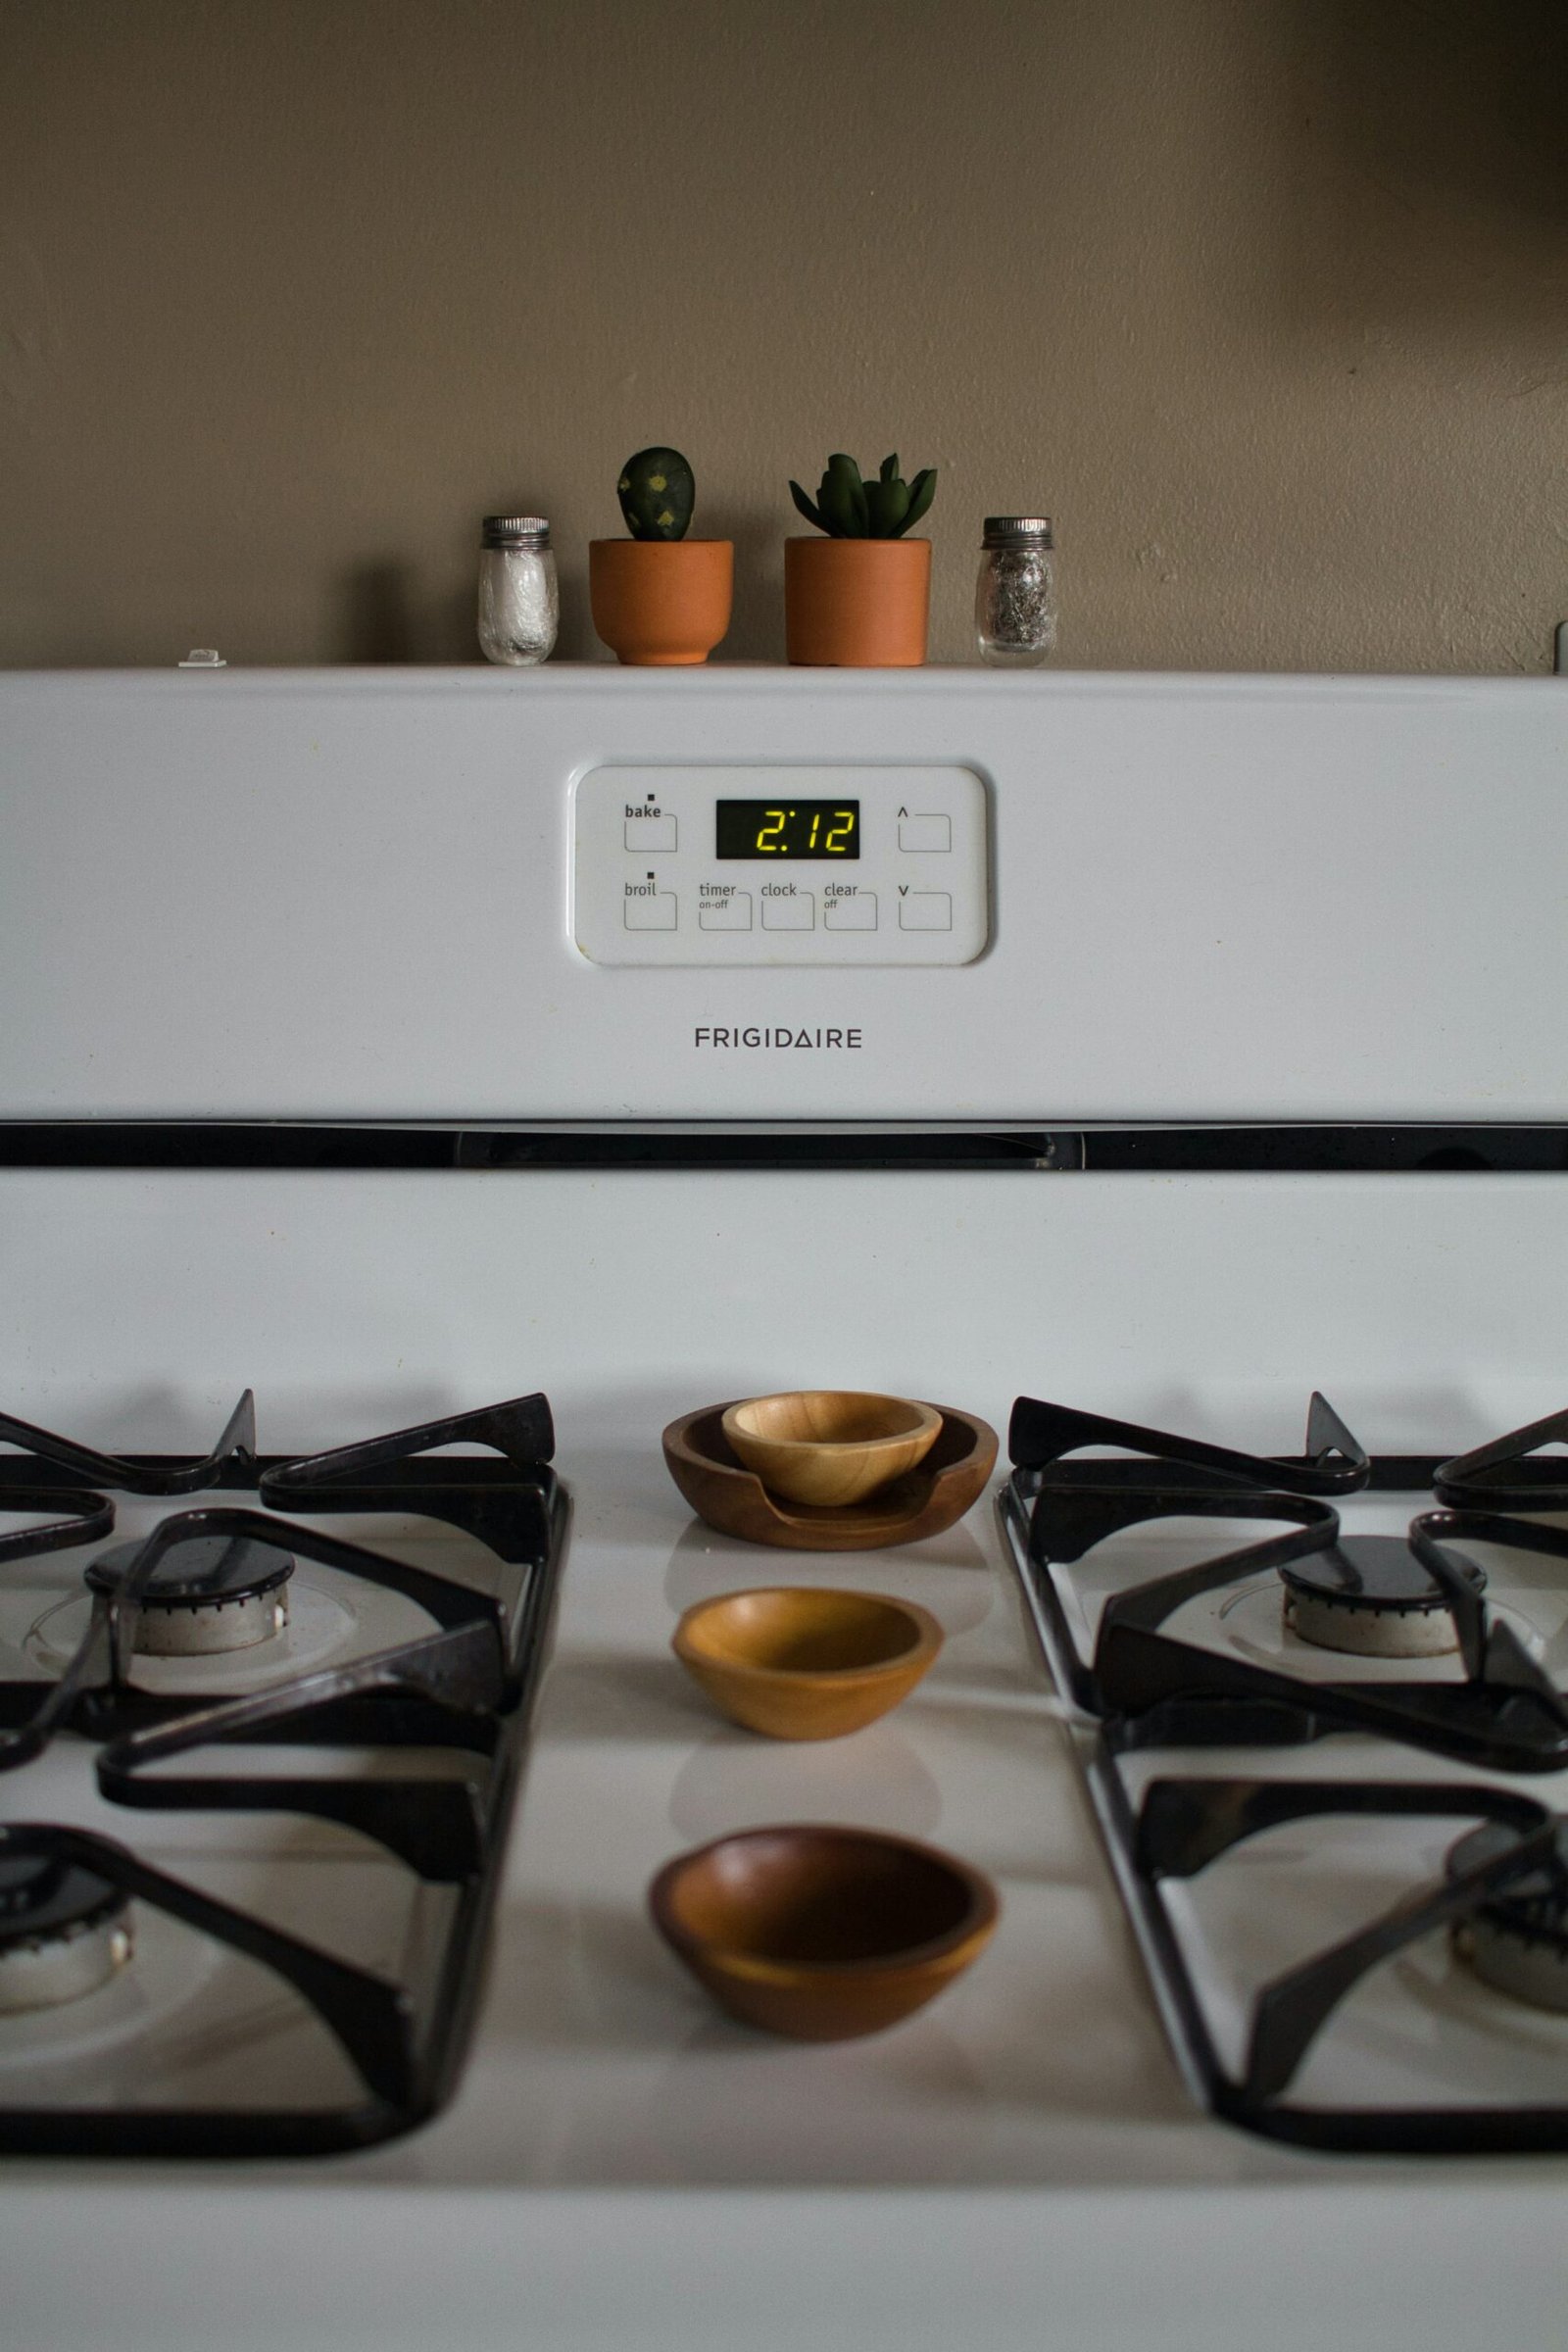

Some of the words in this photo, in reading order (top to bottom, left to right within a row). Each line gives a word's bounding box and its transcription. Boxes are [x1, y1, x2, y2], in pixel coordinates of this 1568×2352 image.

[625, 804, 662, 817] bake
[624, 882, 657, 896] broil
[699, 883, 736, 896] timer
[760, 883, 797, 896] clock
[824, 883, 858, 896] clear
[699, 900, 728, 908] on-off
[824, 900, 838, 908] off
[695, 1027, 862, 1049] FRIGIDAIRE
